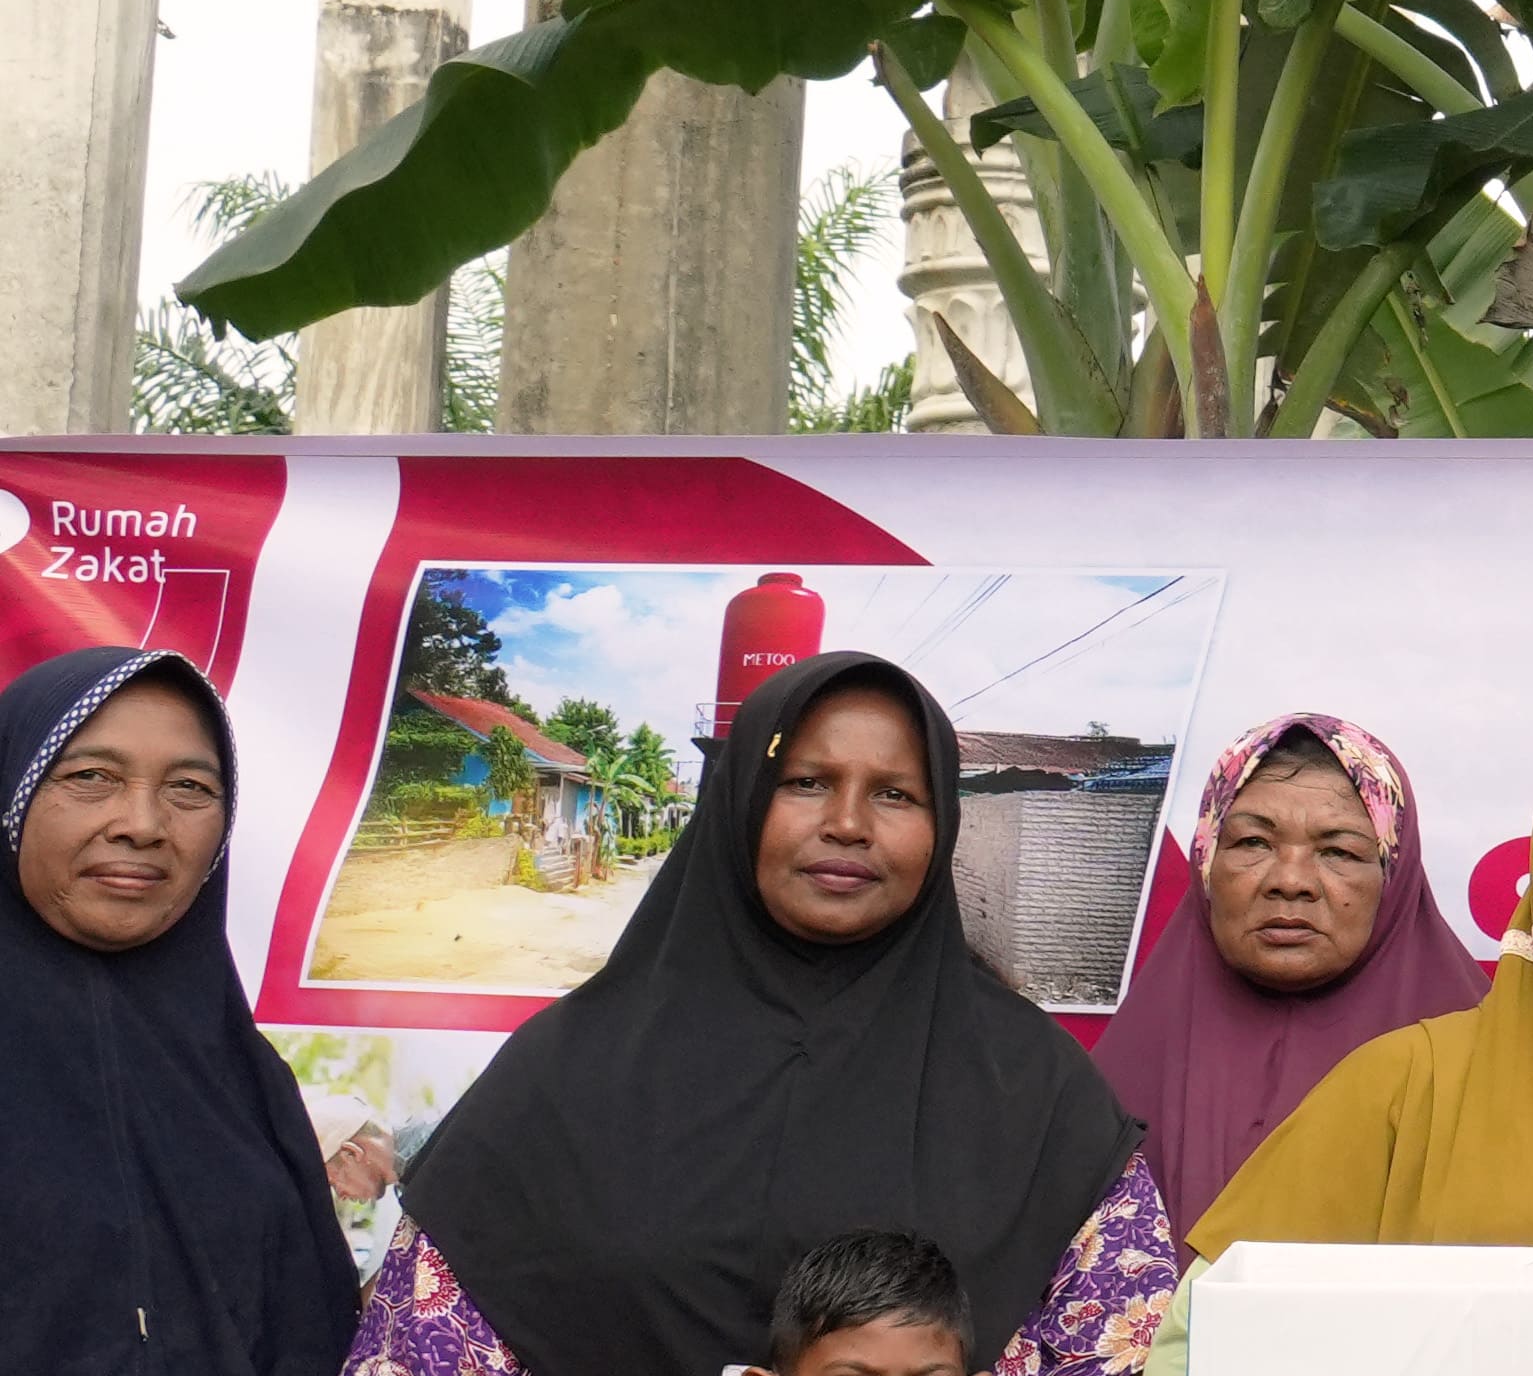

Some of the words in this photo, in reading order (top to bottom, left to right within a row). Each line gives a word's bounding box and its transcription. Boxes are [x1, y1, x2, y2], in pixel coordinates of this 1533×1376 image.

[51, 500, 198, 538] Rumah
[40, 545, 167, 584] Zakat
[742, 652, 796, 667] METOO
